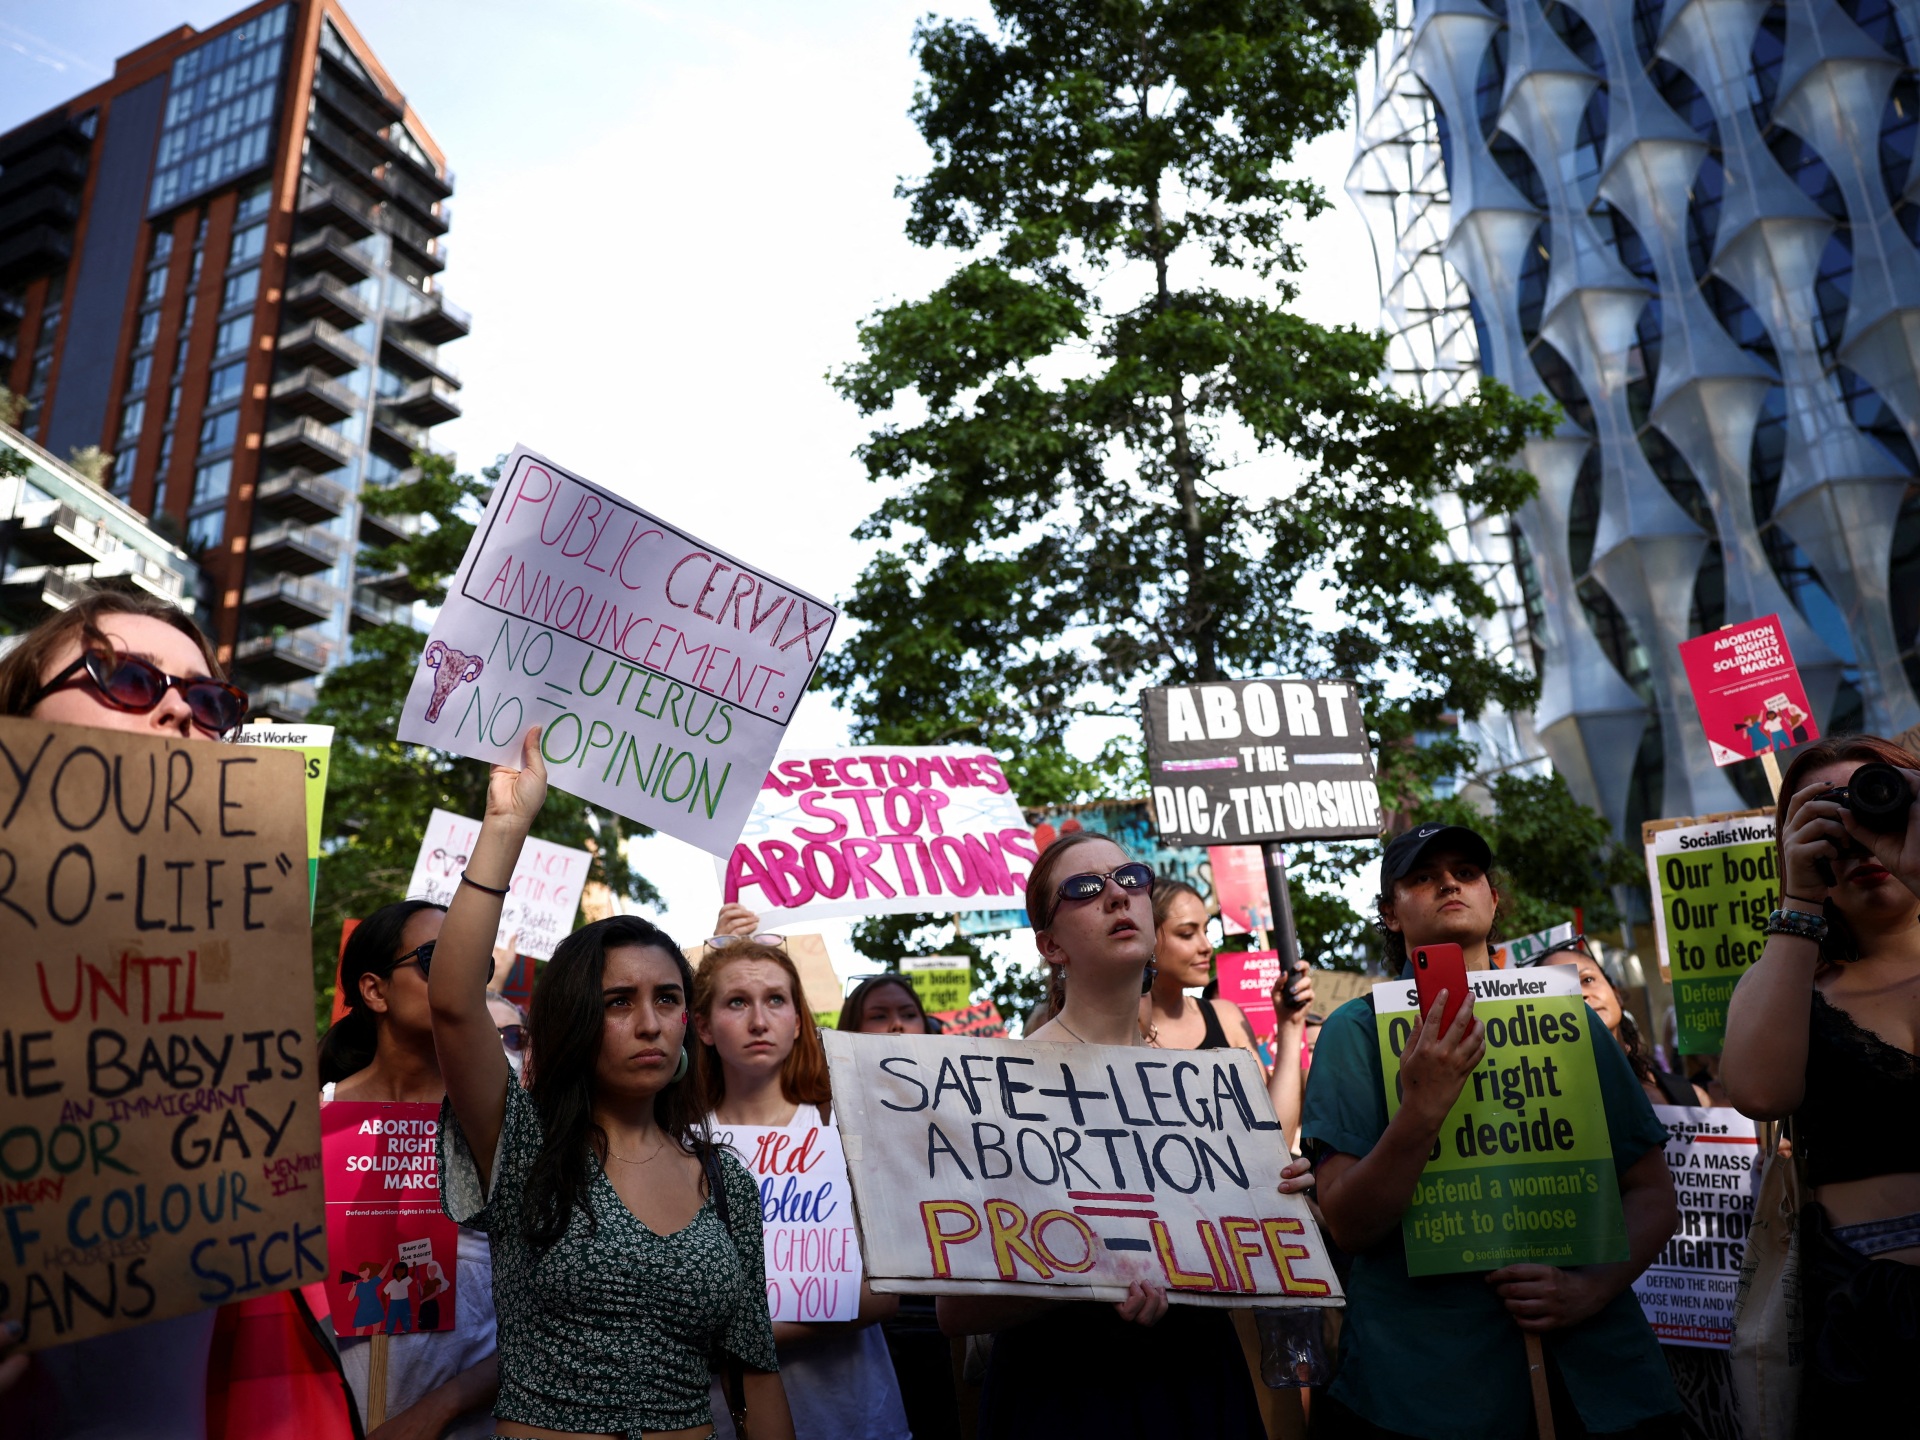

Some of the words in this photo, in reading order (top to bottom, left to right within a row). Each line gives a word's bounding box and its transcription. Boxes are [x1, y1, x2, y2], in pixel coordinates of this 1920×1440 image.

[506, 465, 664, 590] PUBLIC
[665, 552, 831, 662] CERVIX
[483, 555, 786, 713] ANNOUNCEMENT:
[1714, 625, 1775, 652] ABORTION
[1734, 635, 1779, 656] RIGHTS
[1712, 645, 1781, 673] SOLIDARITY
[1740, 655, 1785, 675] MARCH
[487, 618, 554, 677] NO
[578, 650, 734, 746] UTERUS
[1167, 682, 1349, 742] ABORT
[454, 686, 523, 747] NO
[540, 712, 732, 820] OPINION
[1239, 745, 1290, 773] THE
[0, 734, 257, 836] YOU'RE
[761, 754, 1010, 797] ASECTOMIES
[792, 786, 950, 843] STOP
[1738, 826, 1777, 842] Work
[532, 850, 575, 878] NOT
[724, 828, 1039, 908] ABORTIONS
[1666, 858, 1713, 891] Our
[1722, 846, 1780, 885] bodi
[1671, 897, 1719, 931] Our
[1729, 887, 1780, 931] righ
[1677, 940, 1705, 971] to
[36, 951, 224, 1023] UNTIL
[1482, 979, 1547, 998] Worker
[1681, 983, 1734, 1004] Defen
[1483, 1004, 1581, 1048] odies
[1684, 1008, 1720, 1031] right
[87, 1029, 233, 1098] BABY
[242, 1029, 302, 1082] IS
[1473, 1055, 1562, 1110] right
[59, 1099, 94, 1124] AN
[107, 1084, 251, 1122] IMMIGRANT
[171, 1101, 296, 1169] GAY
[358, 1119, 438, 1135] ABORTIO
[387, 1138, 437, 1153] RIGHT
[1455, 1107, 1576, 1159] decide
[1664, 1121, 1729, 1135] ocialist
[345, 1155, 439, 1172] SOLIDARIT
[746, 1127, 825, 1175] red
[928, 1122, 1250, 1194] ABORTION
[1689, 1154, 1700, 1169] A
[1704, 1155, 1751, 1171] MASS
[272, 1176, 307, 1197] ILL
[760, 1175, 838, 1223] blue
[1411, 1174, 1482, 1206] Defend
[1489, 1180, 1502, 1198] a
[1509, 1167, 1598, 1197] woman's
[1676, 1191, 1714, 1208] IGHT
[1719, 1193, 1754, 1211] FOR
[67, 1170, 262, 1248] COLOUR
[399, 1208, 418, 1216] rights
[1414, 1211, 1466, 1243] right
[1471, 1209, 1494, 1234] to
[1502, 1205, 1577, 1231] choose
[191, 1223, 324, 1303] SICK
[773, 1227, 855, 1273] CHOICE
[920, 1199, 1331, 1297] PRO-LIFE
[1475, 1245, 1573, 1262] socialistworker.co.uk
[790, 1276, 839, 1321] YOU
[1636, 1292, 1668, 1307] HOOSE
[1670, 1294, 1701, 1309] WHEN
[1703, 1296, 1724, 1311] AND
[1646, 1275, 1685, 1290] DEFEND
[1686, 1278, 1706, 1292] THE
[1708, 1279, 1738, 1294] RIGHT
[1655, 1311, 1668, 1324] TO
[1670, 1312, 1697, 1327] HAVE
